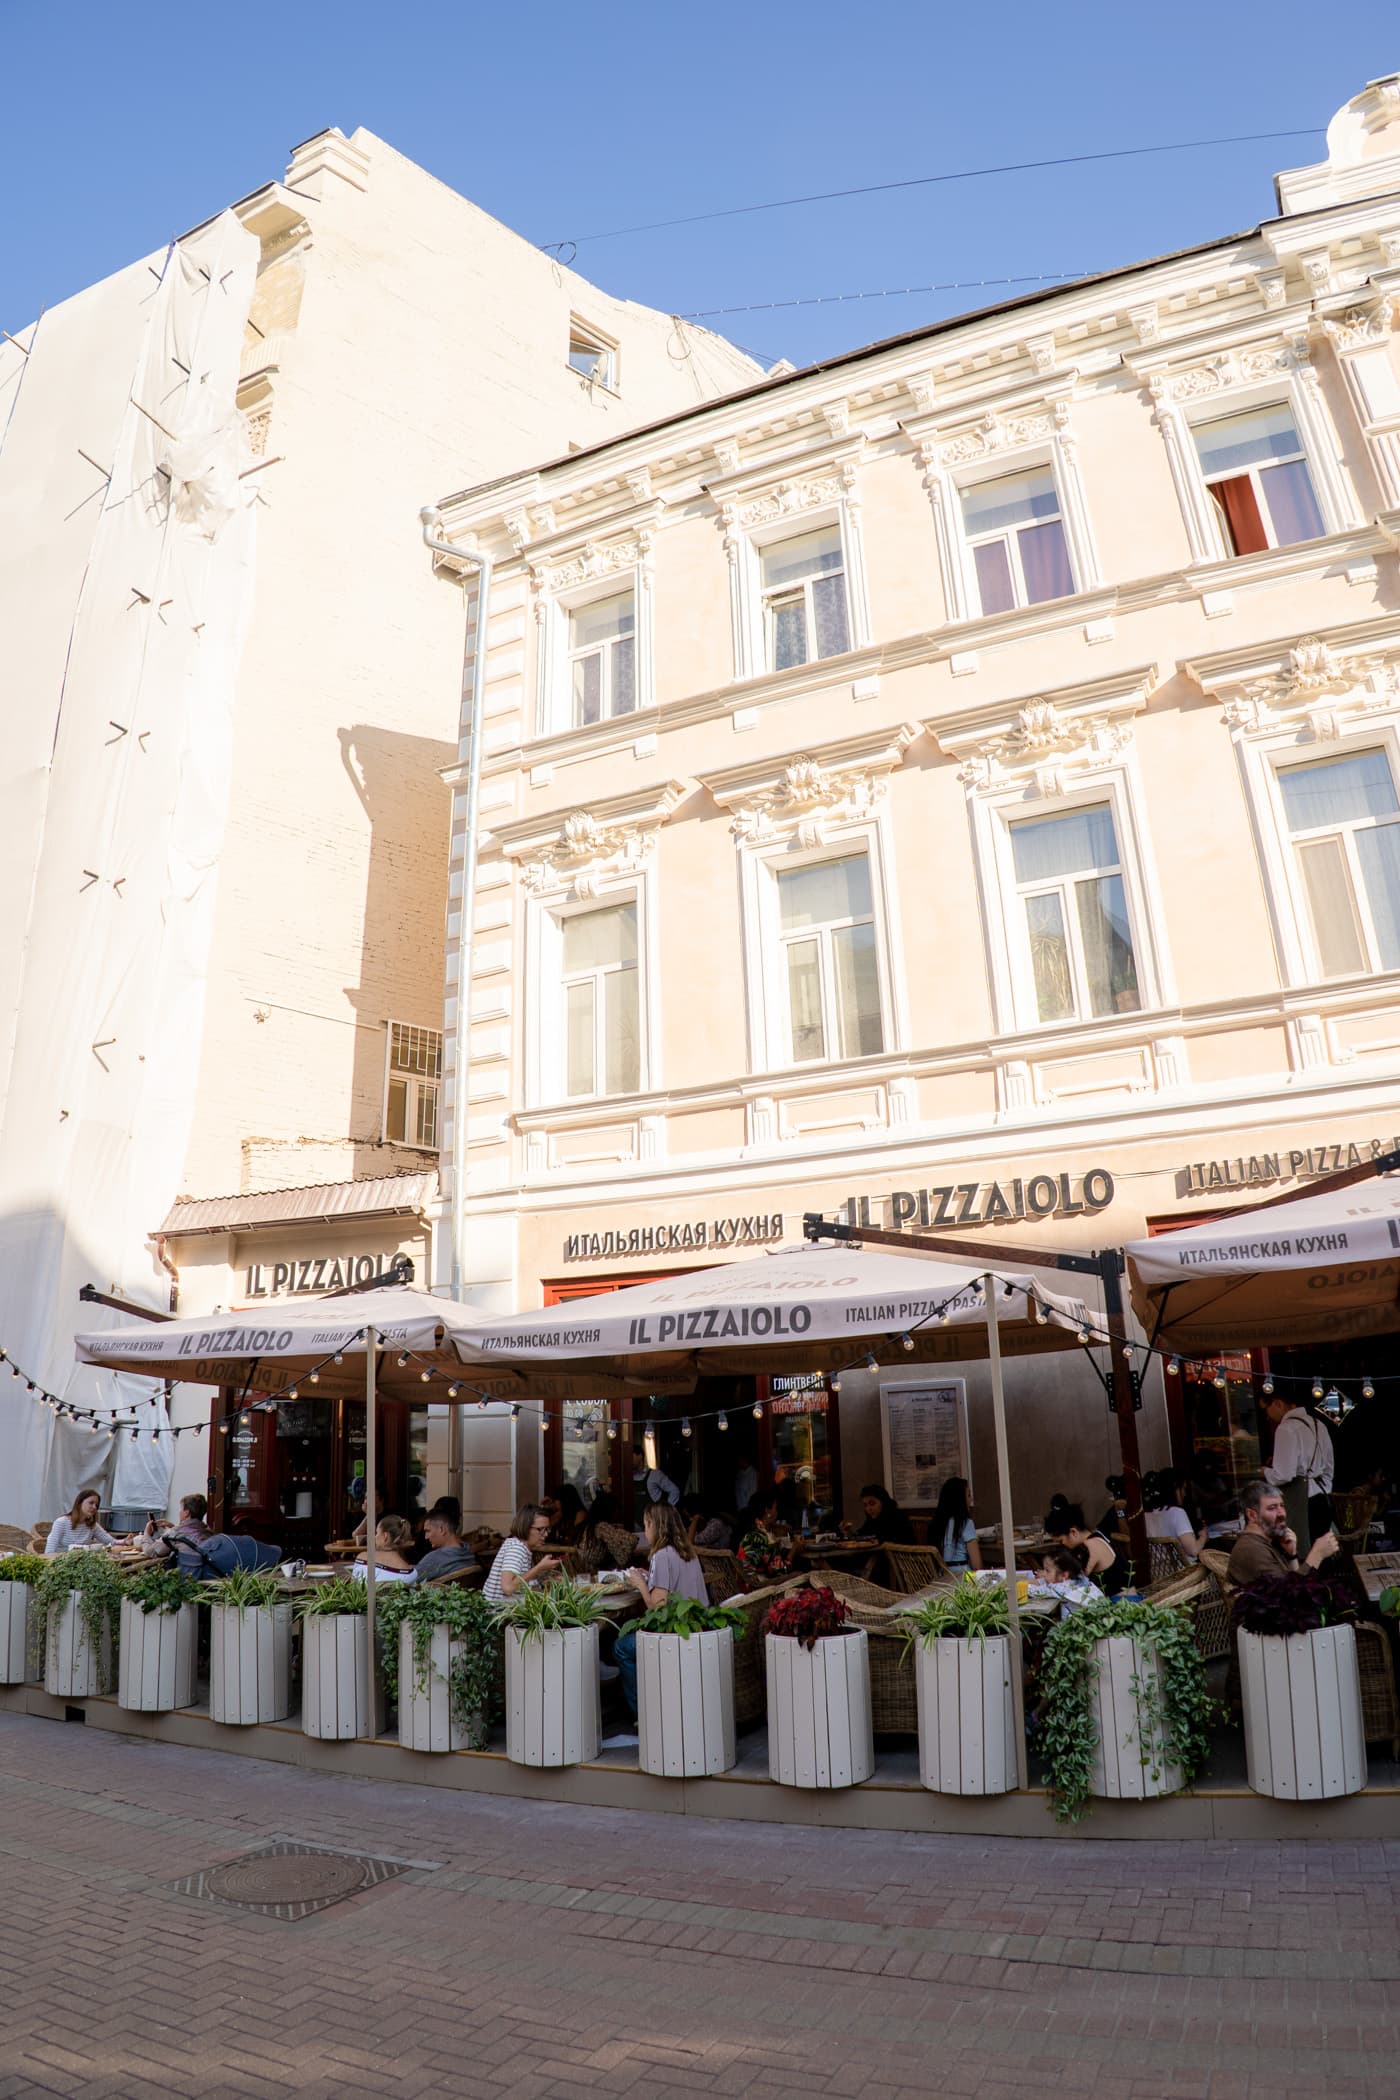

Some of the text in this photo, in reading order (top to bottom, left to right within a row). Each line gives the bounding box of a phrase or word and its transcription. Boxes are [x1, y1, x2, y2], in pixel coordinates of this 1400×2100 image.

[1185, 1153, 1282, 1190] ITALIAN
[1288, 1142, 1363, 1177] PIZZA
[847, 1168, 1115, 1231] IL PIZZAIOLO
[567, 1213, 784, 1257] ИТАЛЬЯНСКАЯ КУХНЯ
[1179, 1232, 1349, 1266] ИТАЛЬЯНСКАЯ КУХНЯ
[247, 1263, 266, 1295] IL
[628, 1304, 812, 1346] IL PIZZAIOLO
[845, 1304, 896, 1324] ITALIAN
[899, 1300, 938, 1319] PIZZA
[953, 1295, 987, 1312] PAST
[139, 1340, 165, 1352] КУХНЯ
[178, 1330, 293, 1355] IL PIZZAIOLO
[311, 1331, 344, 1344] ITALIAN
[481, 1328, 601, 1351] ИТАЛЬЯНСКАЯ КУХНЯ
